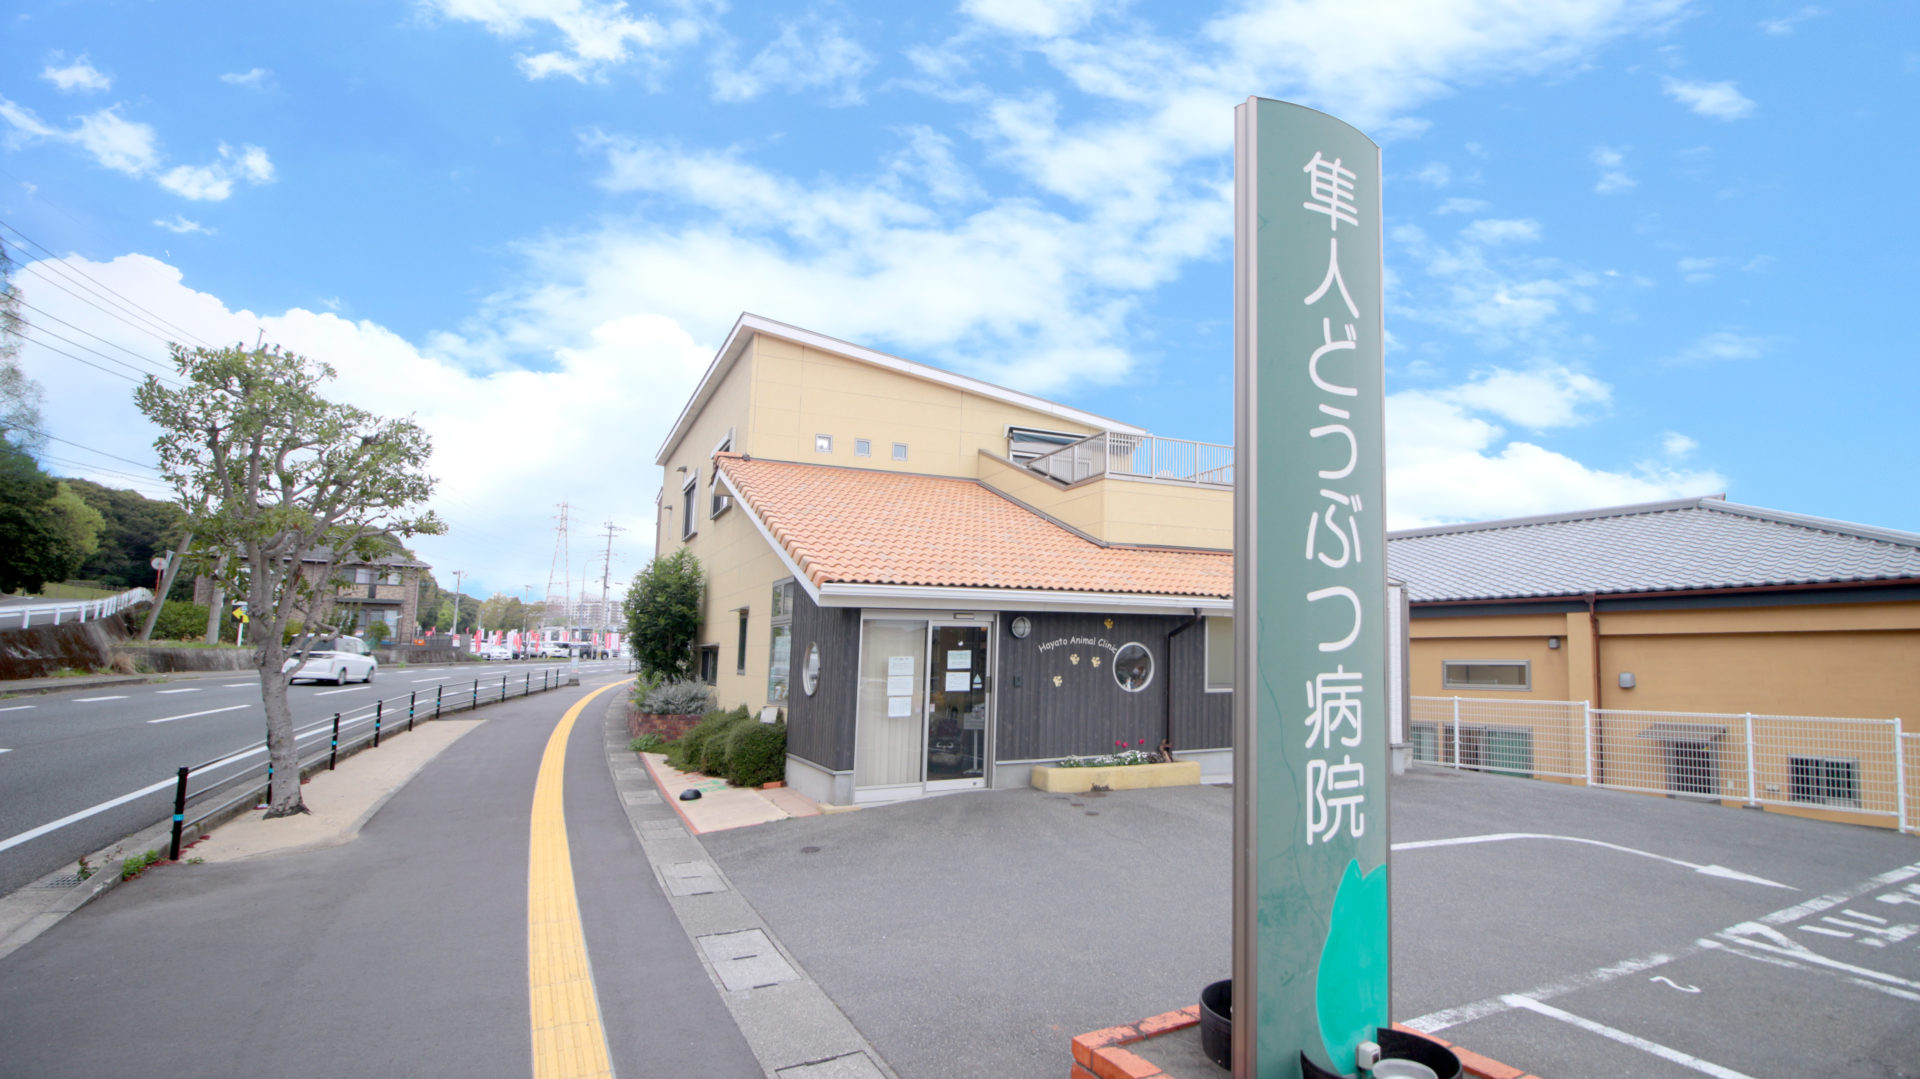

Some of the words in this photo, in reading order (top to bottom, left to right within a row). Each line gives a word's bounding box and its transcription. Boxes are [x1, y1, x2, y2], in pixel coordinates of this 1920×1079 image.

[1038, 638, 1068, 653] Hayato
[1070, 635, 1096, 646] Animal
[1097, 638, 1118, 655] Clinic
[1303, 151, 1364, 846] 隼人どうぶつ病院
